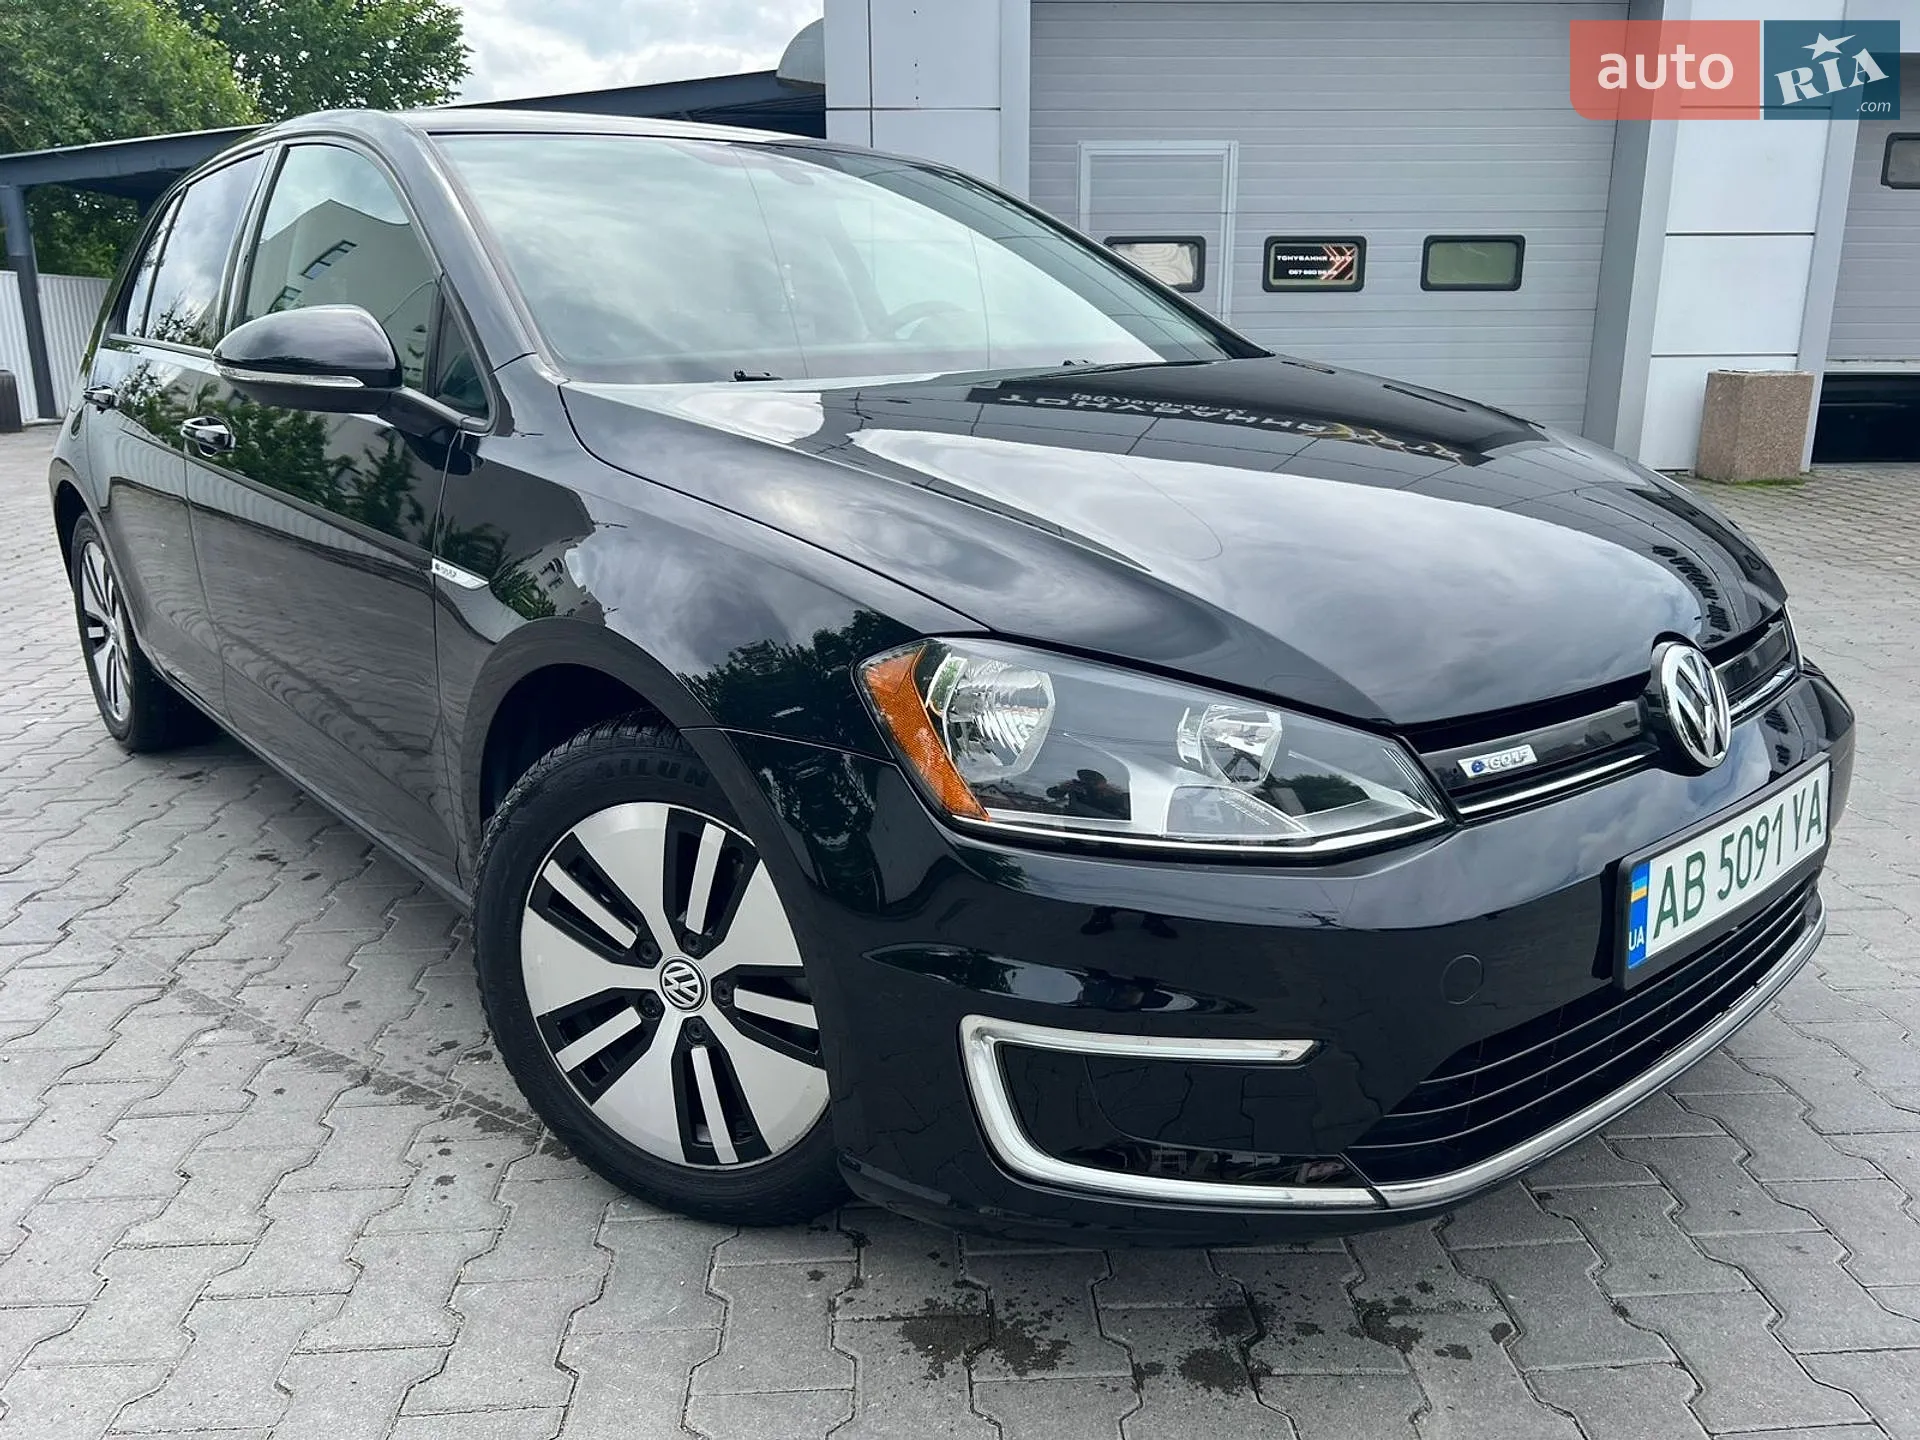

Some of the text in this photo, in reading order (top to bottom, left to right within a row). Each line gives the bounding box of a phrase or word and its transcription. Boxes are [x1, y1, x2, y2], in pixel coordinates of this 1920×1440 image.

[1653, 779, 1822, 940] AB 5091 YA
[1629, 926, 1645, 951] UA
